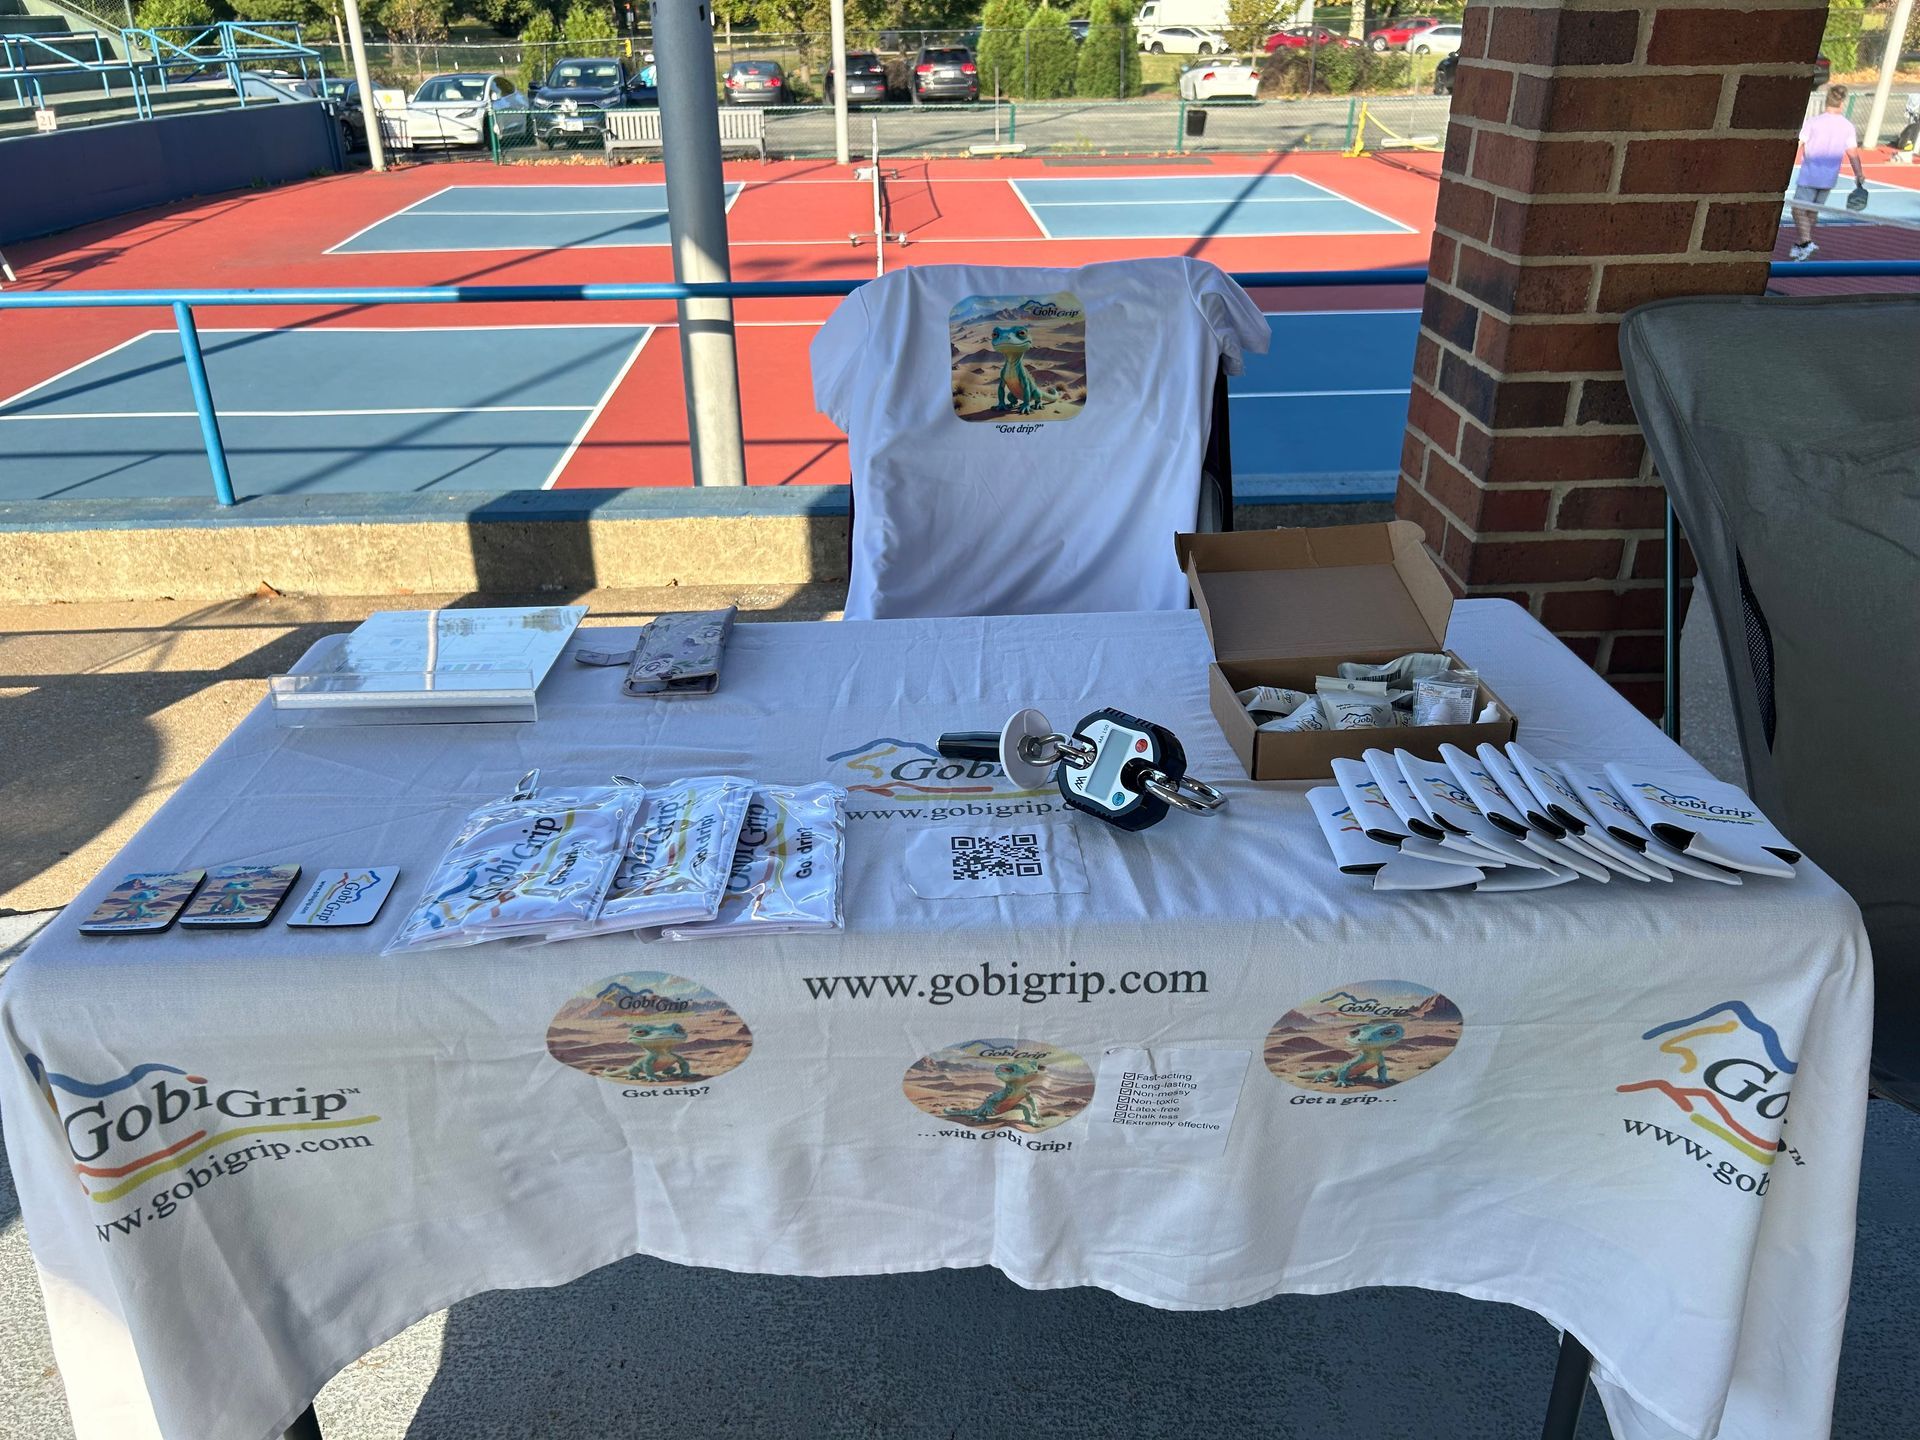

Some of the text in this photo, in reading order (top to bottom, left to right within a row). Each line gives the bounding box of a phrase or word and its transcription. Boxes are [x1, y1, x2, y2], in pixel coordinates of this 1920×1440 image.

[845, 801, 1076, 820] www.gobigrip.c
[803, 961, 1209, 1005] www.gobigrip.com
[1136, 1072, 1193, 1081] Fast-acting
[1134, 1081, 1198, 1090] Long-lasting
[622, 1086, 711, 1098] Got drip?
[1132, 1089, 1191, 1097] Non-messy
[1290, 1095, 1324, 1105] Get
[1129, 1105, 1180, 1113] Latex-free
[1125, 1120, 1221, 1130] Extremely effective
[981, 1130, 1023, 1146] Gobi
[1026, 1141, 1073, 1153] Grip!
[96, 1134, 374, 1242] ww.gobigrip.com
